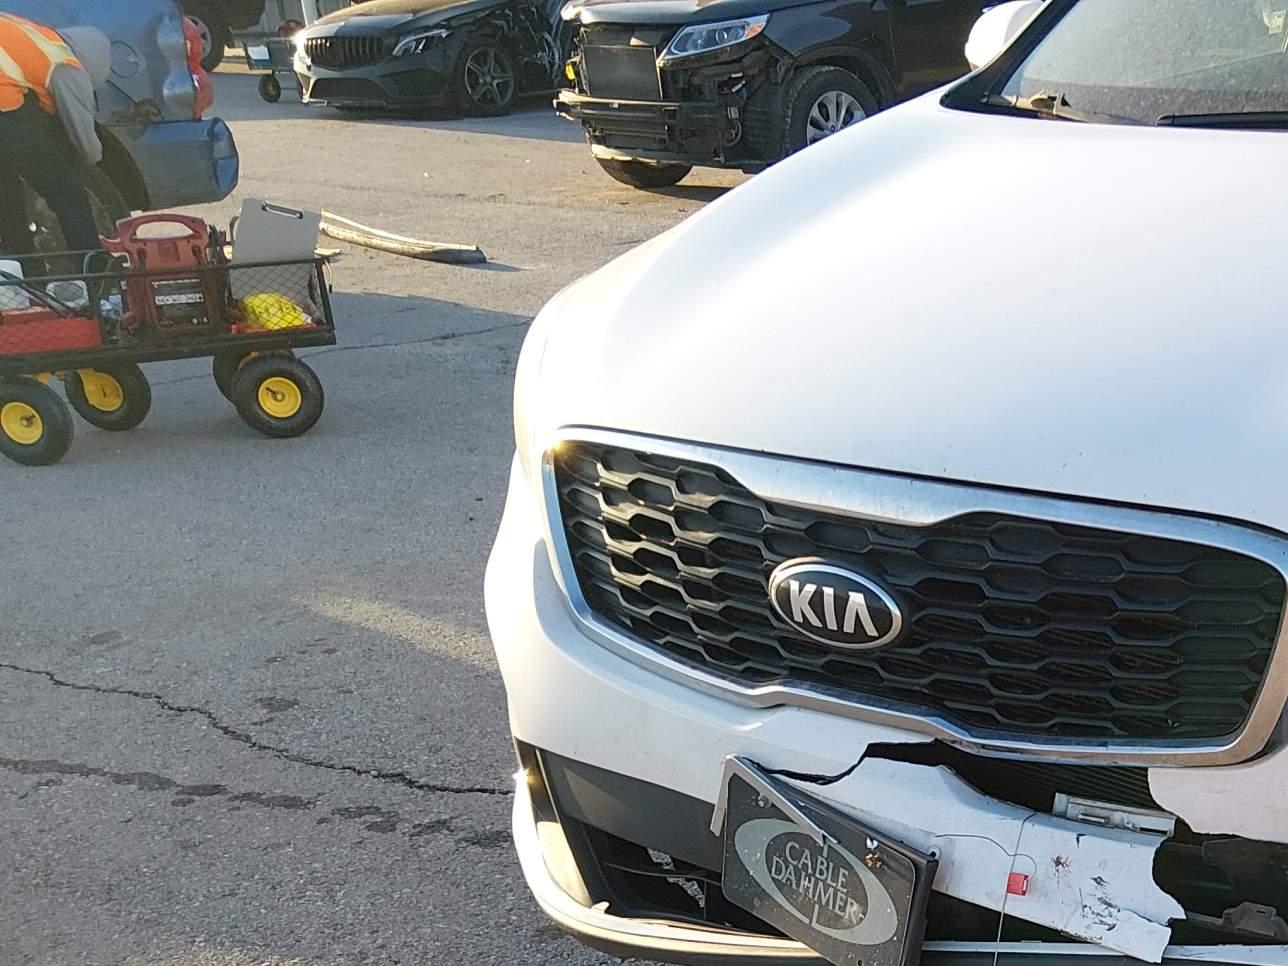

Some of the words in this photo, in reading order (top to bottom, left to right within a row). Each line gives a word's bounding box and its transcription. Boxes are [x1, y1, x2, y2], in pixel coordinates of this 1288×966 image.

[788, 579, 879, 637] KIA
[770, 855, 858, 925] DAHMER
[784, 840, 850, 893] CABLE
